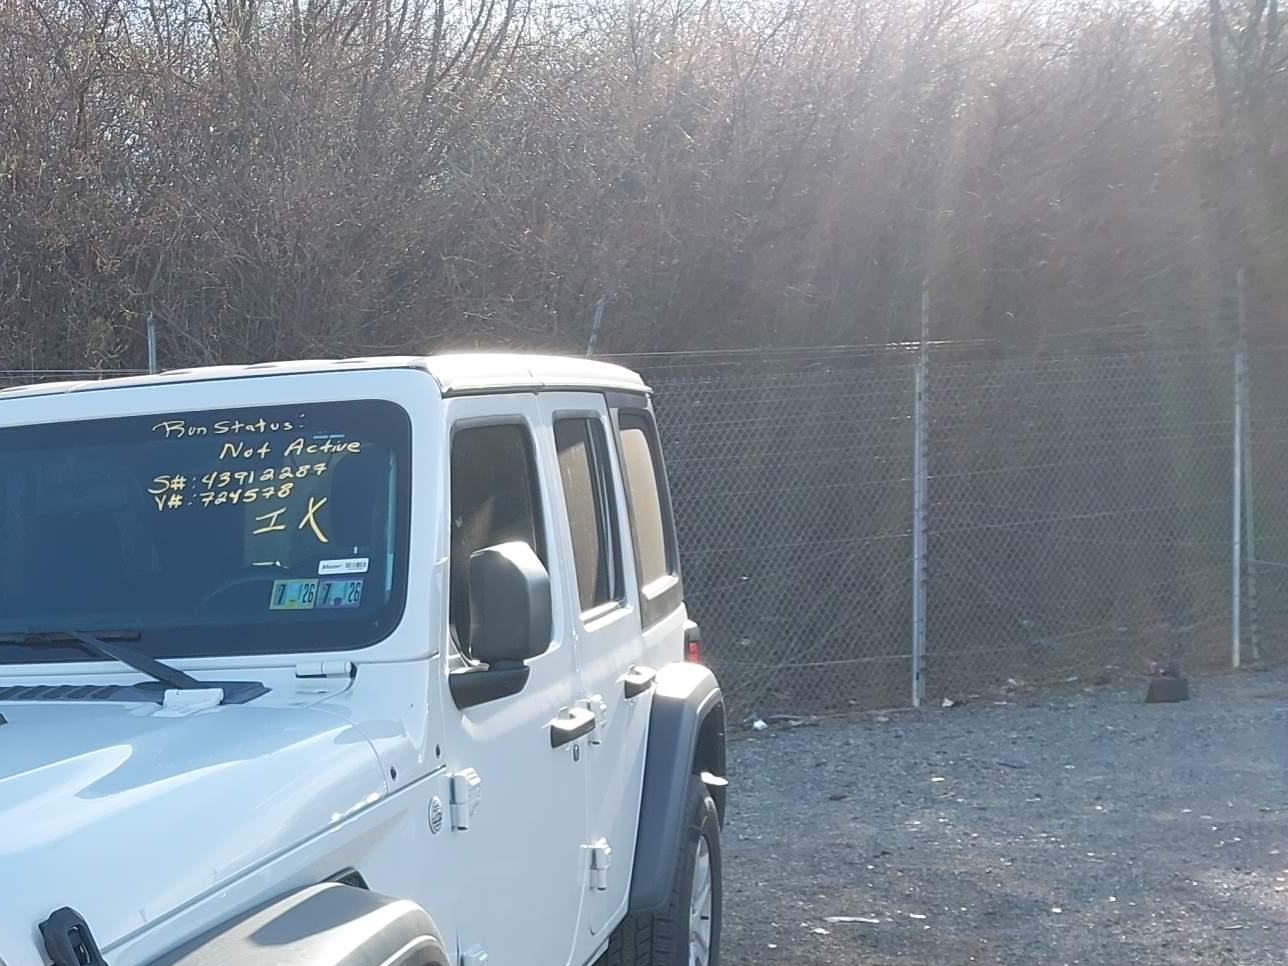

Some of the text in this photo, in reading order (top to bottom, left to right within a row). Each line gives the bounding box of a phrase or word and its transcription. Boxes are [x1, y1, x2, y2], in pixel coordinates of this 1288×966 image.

[152, 420, 208, 438] Run
[219, 438, 361, 459] Not Active
